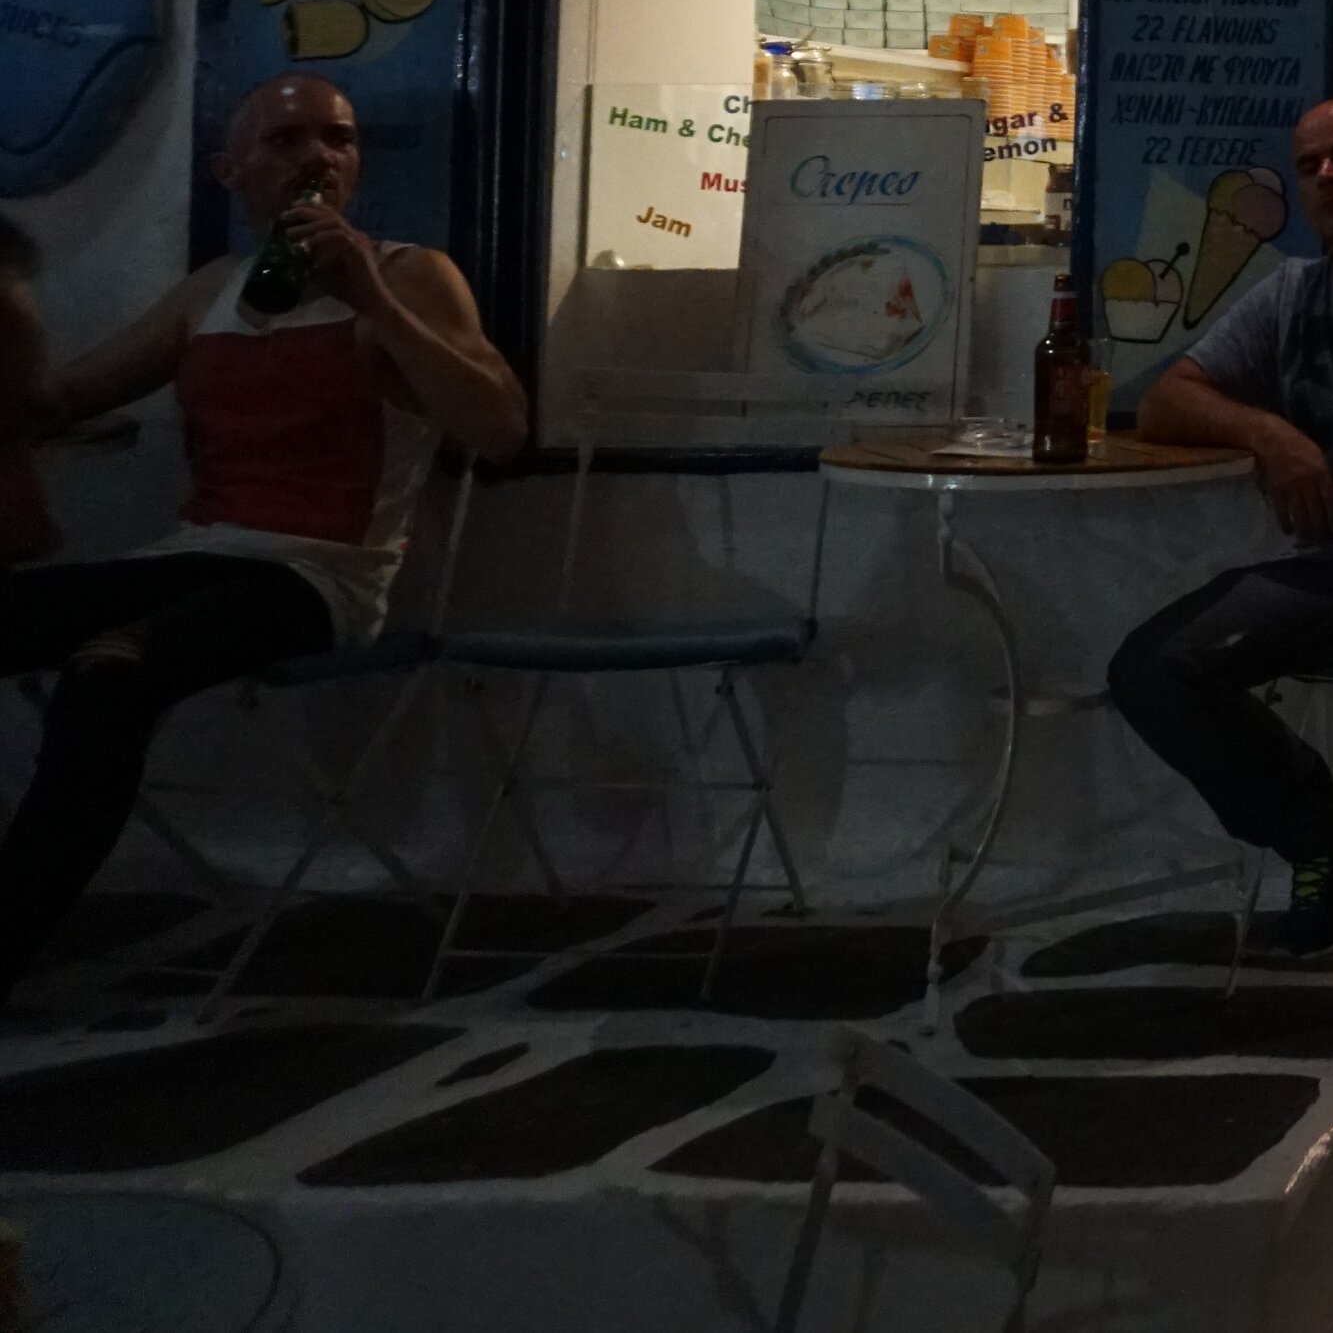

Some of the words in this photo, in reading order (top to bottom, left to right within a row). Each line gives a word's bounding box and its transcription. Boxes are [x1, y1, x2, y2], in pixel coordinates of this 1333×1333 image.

[1131, 14, 1165, 42] 22
[1172, 16, 1280, 45] FLAVOURS
[1110, 52, 1185, 83] ΠΑΓΩΤΟ
[1188, 54, 1220, 83] ΜΕ
[1224, 56, 1302, 86] ΦΡΟΥΤΑ
[608, 106, 669, 134] Ham
[677, 118, 697, 139] &
[1049, 102, 1069, 123] &
[1141, 136, 1172, 165] 22
[1177, 137, 1264, 166] ΓΕΥΣΕΙΣ
[789, 154, 922, 205] Crepes
[636, 206, 693, 239] Jam
